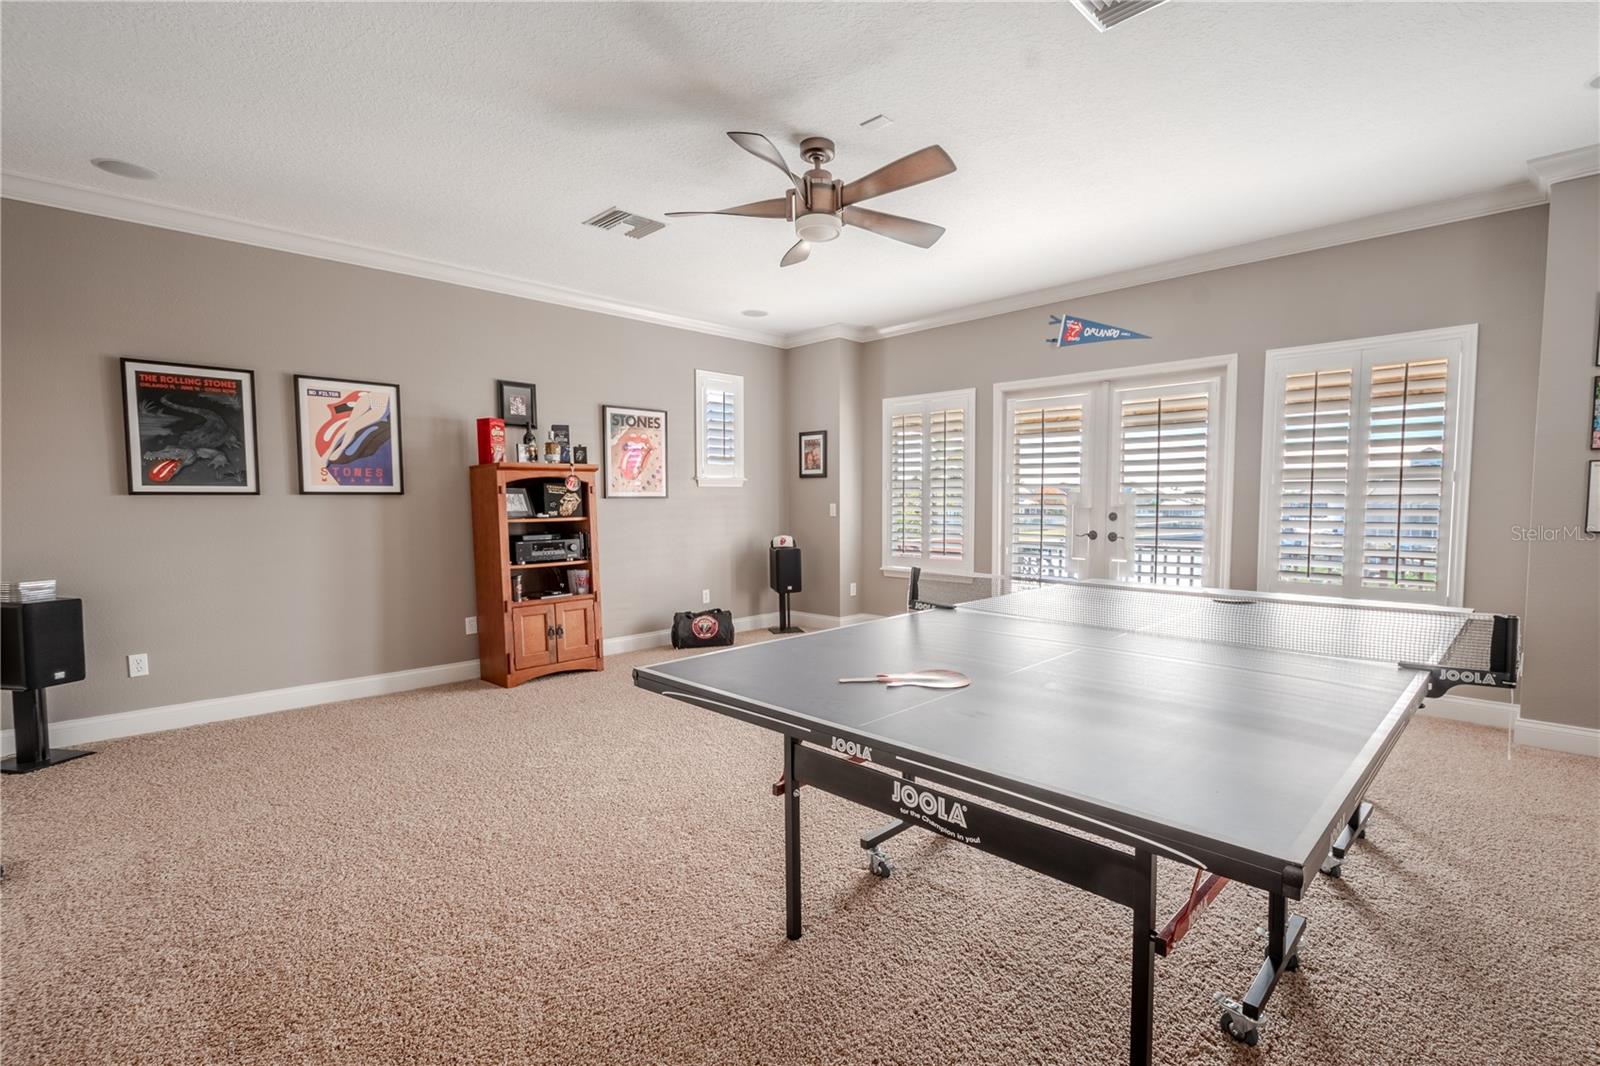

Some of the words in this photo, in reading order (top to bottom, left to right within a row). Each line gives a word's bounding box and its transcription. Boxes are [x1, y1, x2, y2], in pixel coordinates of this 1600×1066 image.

[1084, 327, 1120, 338] ORLANDO
[139, 374, 157, 382] THE
[160, 376, 201, 386] ROLLING
[204, 380, 236, 389] STONES
[611, 414, 661, 429] STONES
[320, 467, 384, 478] STONES
[1439, 669, 1497, 685] JOOLA
[831, 736, 872, 761] JOOLA
[892, 780, 968, 829] JOOLA
[899, 807, 909, 815] for
[910, 810, 921, 819] the
[921, 814, 956, 838] Champion
[957, 833, 964, 841] in
